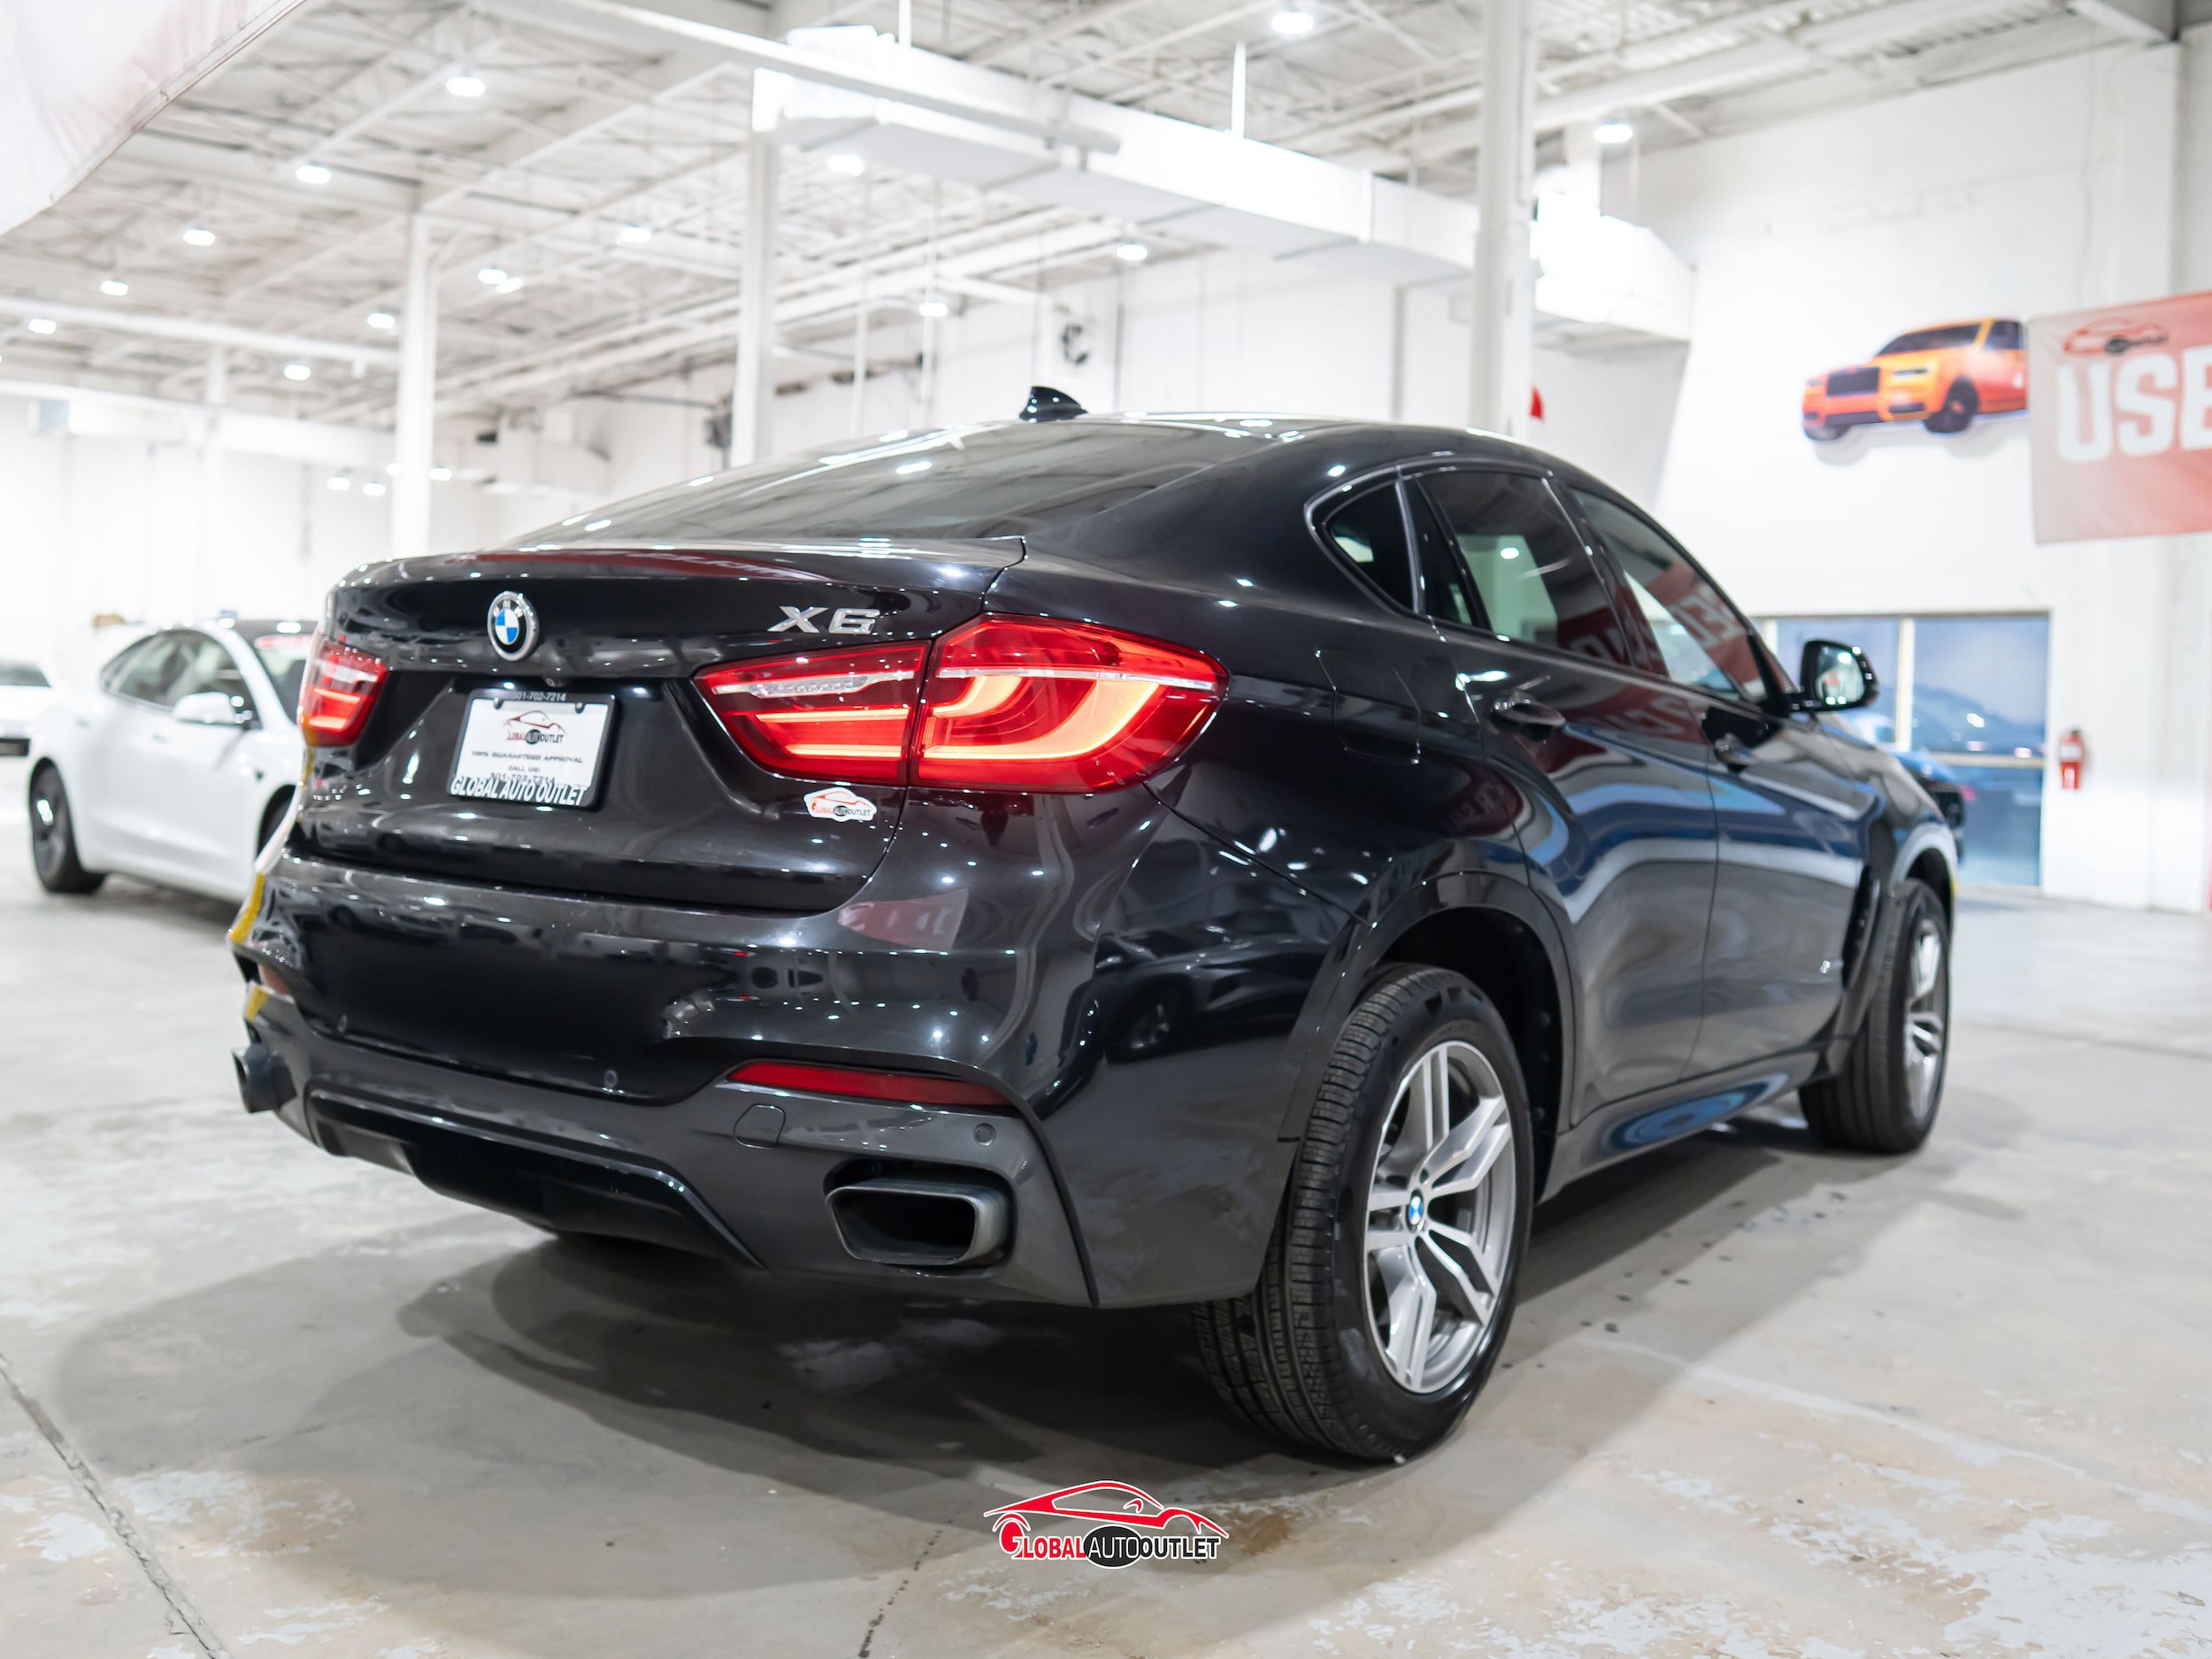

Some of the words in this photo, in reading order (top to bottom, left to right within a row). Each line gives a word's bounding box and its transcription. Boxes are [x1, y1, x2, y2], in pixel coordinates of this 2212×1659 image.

[767, 606, 879, 634] X6
[450, 775, 498, 798] GLOBAL
[499, 778, 535, 802] AUTO
[535, 780, 589, 806] OUTLET
